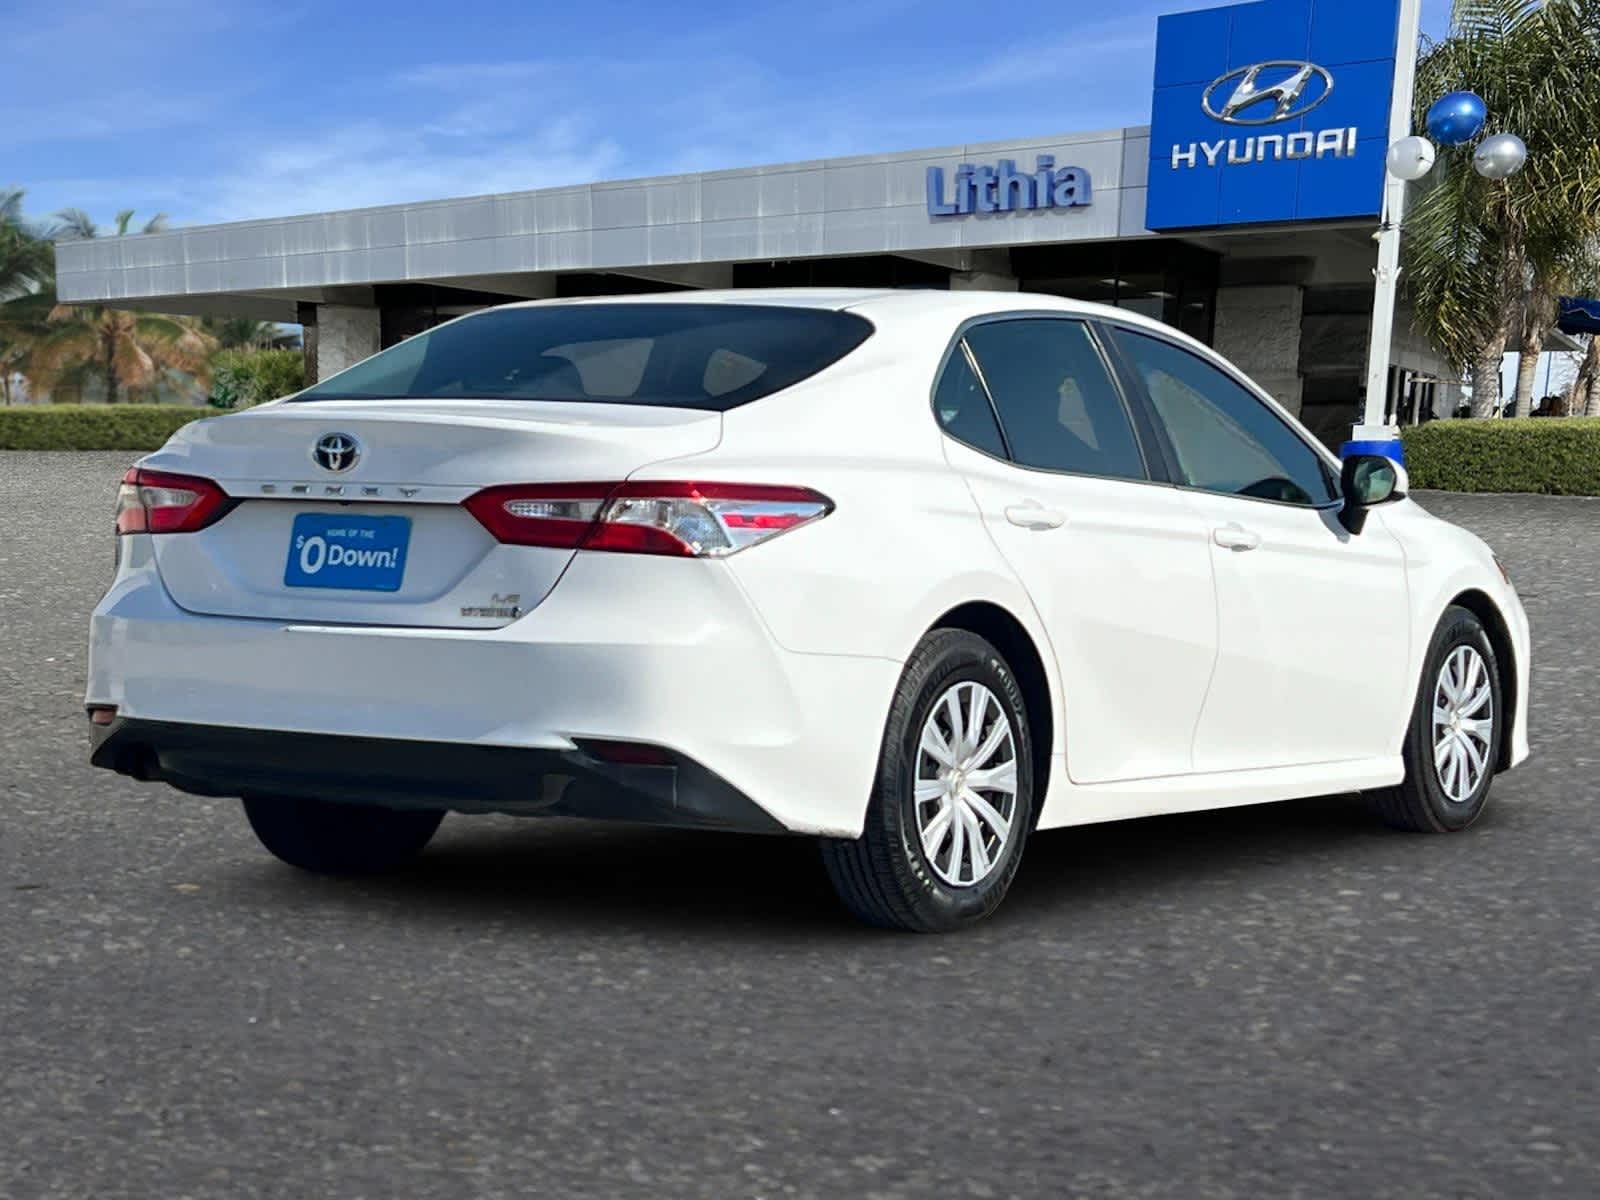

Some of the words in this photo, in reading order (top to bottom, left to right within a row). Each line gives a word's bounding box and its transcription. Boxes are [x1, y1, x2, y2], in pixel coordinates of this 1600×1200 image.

[1171, 127, 1358, 169] HYUNDAI
[926, 154, 1092, 216] Lithia
[348, 529, 359, 538] OF
[360, 529, 376, 539] THE
[327, 544, 399, 569] Down!
